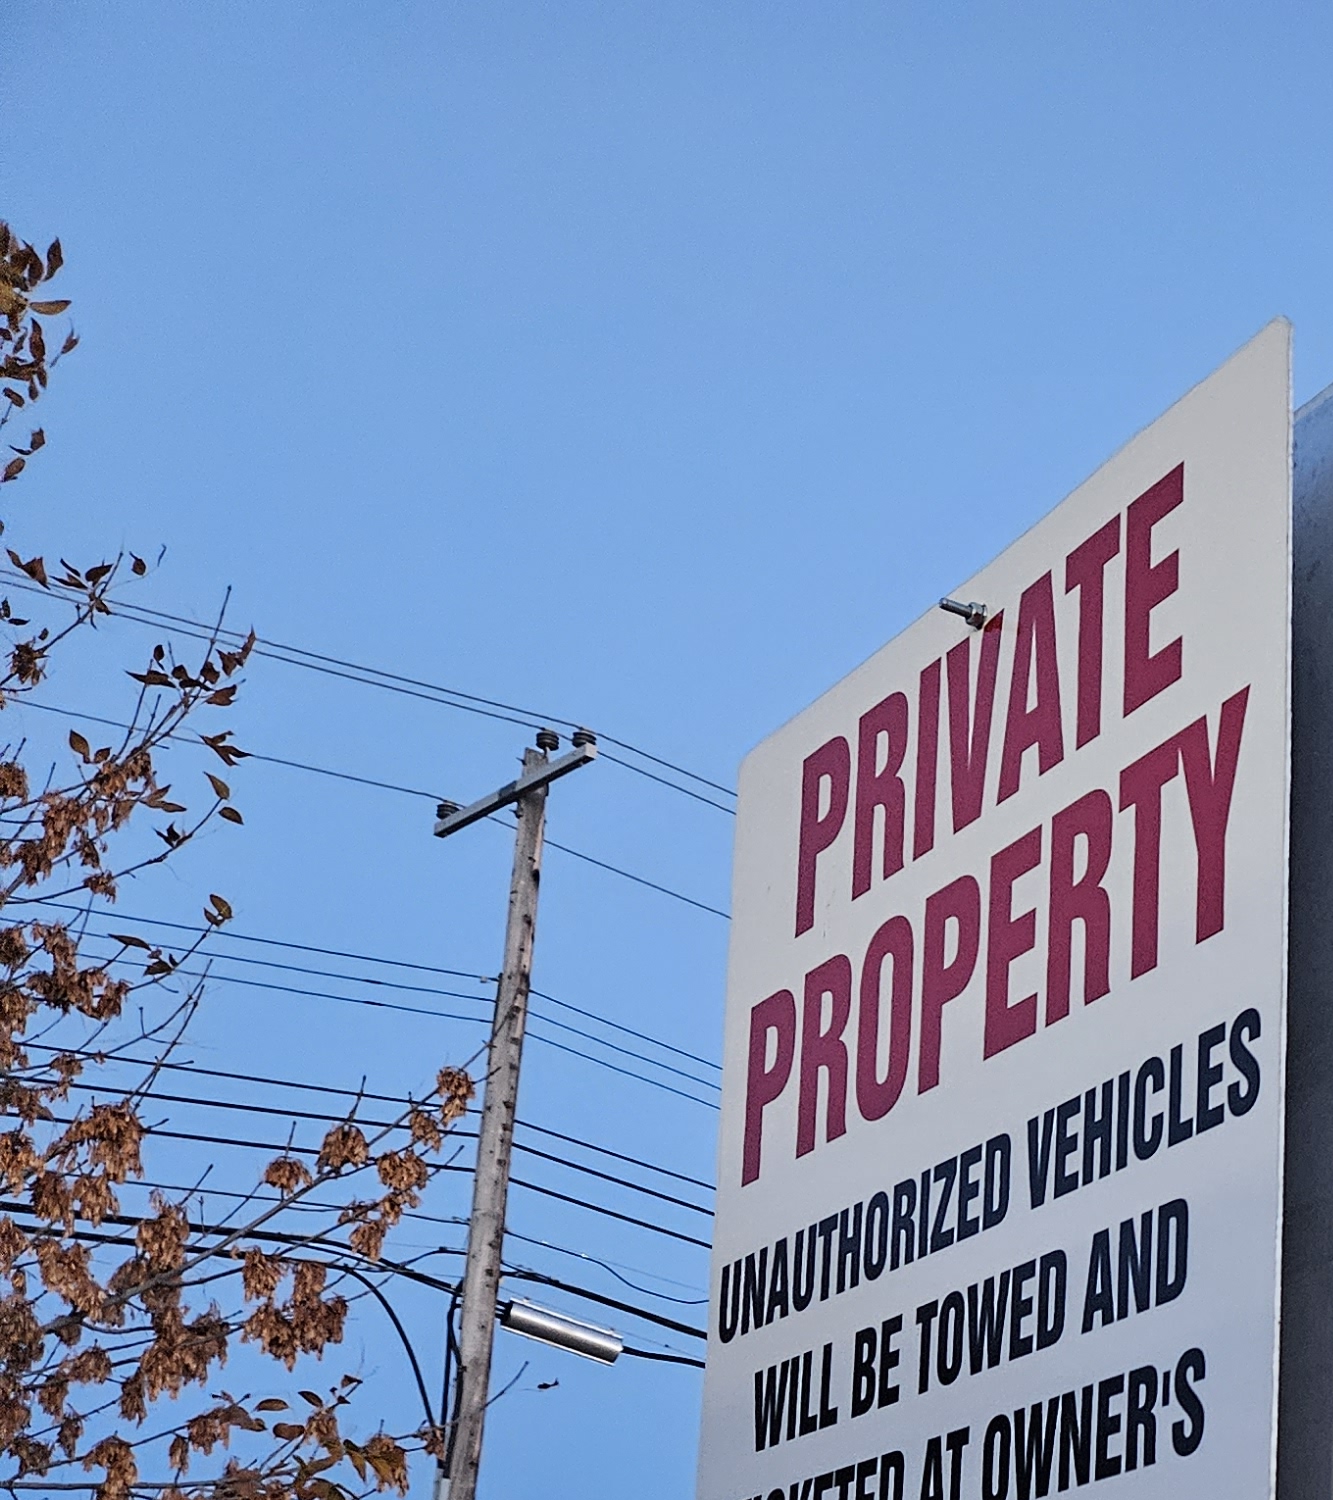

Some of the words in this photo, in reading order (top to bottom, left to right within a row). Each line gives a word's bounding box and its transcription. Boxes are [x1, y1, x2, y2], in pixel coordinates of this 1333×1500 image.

[795, 461, 1185, 938] PRIVATE
[741, 684, 1251, 1187] PROPERTY
[718, 1133, 1011, 1344] UNAUTHORIZED
[1027, 1008, 1262, 1208] VEHICLES
[753, 1342, 838, 1452] WILL
[851, 1314, 901, 1419] BE
[916, 1249, 1067, 1395] TOWED
[1081, 1197, 1189, 1334] AND
